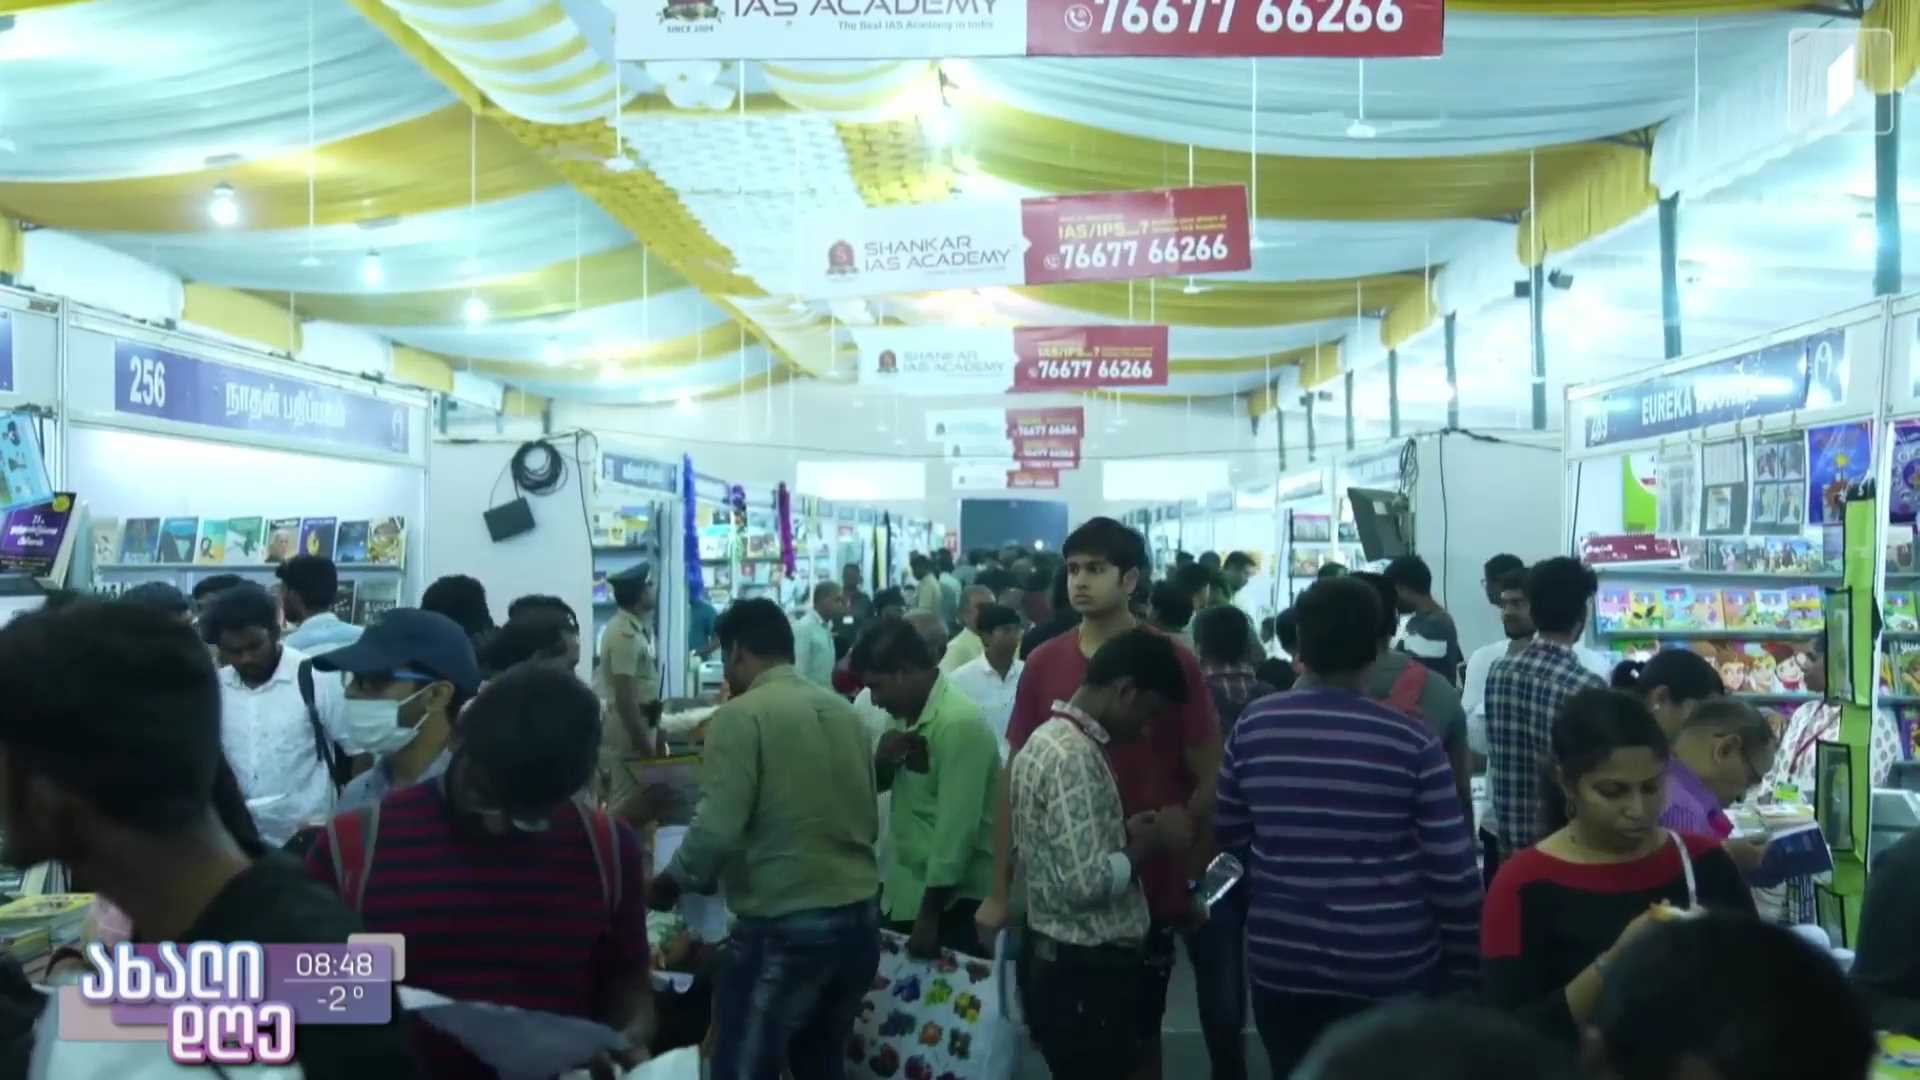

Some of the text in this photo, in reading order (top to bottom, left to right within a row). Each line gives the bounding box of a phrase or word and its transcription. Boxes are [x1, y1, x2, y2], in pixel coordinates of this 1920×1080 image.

[734, 0, 997, 17] IAS ACADEMY
[1095, 0, 1403, 33] 76677 66266
[864, 235, 972, 257] SHANKAR
[865, 256, 900, 272] IAS
[907, 248, 1010, 269] ACADEMY
[1059, 233, 1228, 270] 76677 66266
[129, 355, 166, 408] 256
[1038, 359, 1153, 378] 76677 66266
[1641, 384, 1692, 426] EUREKA
